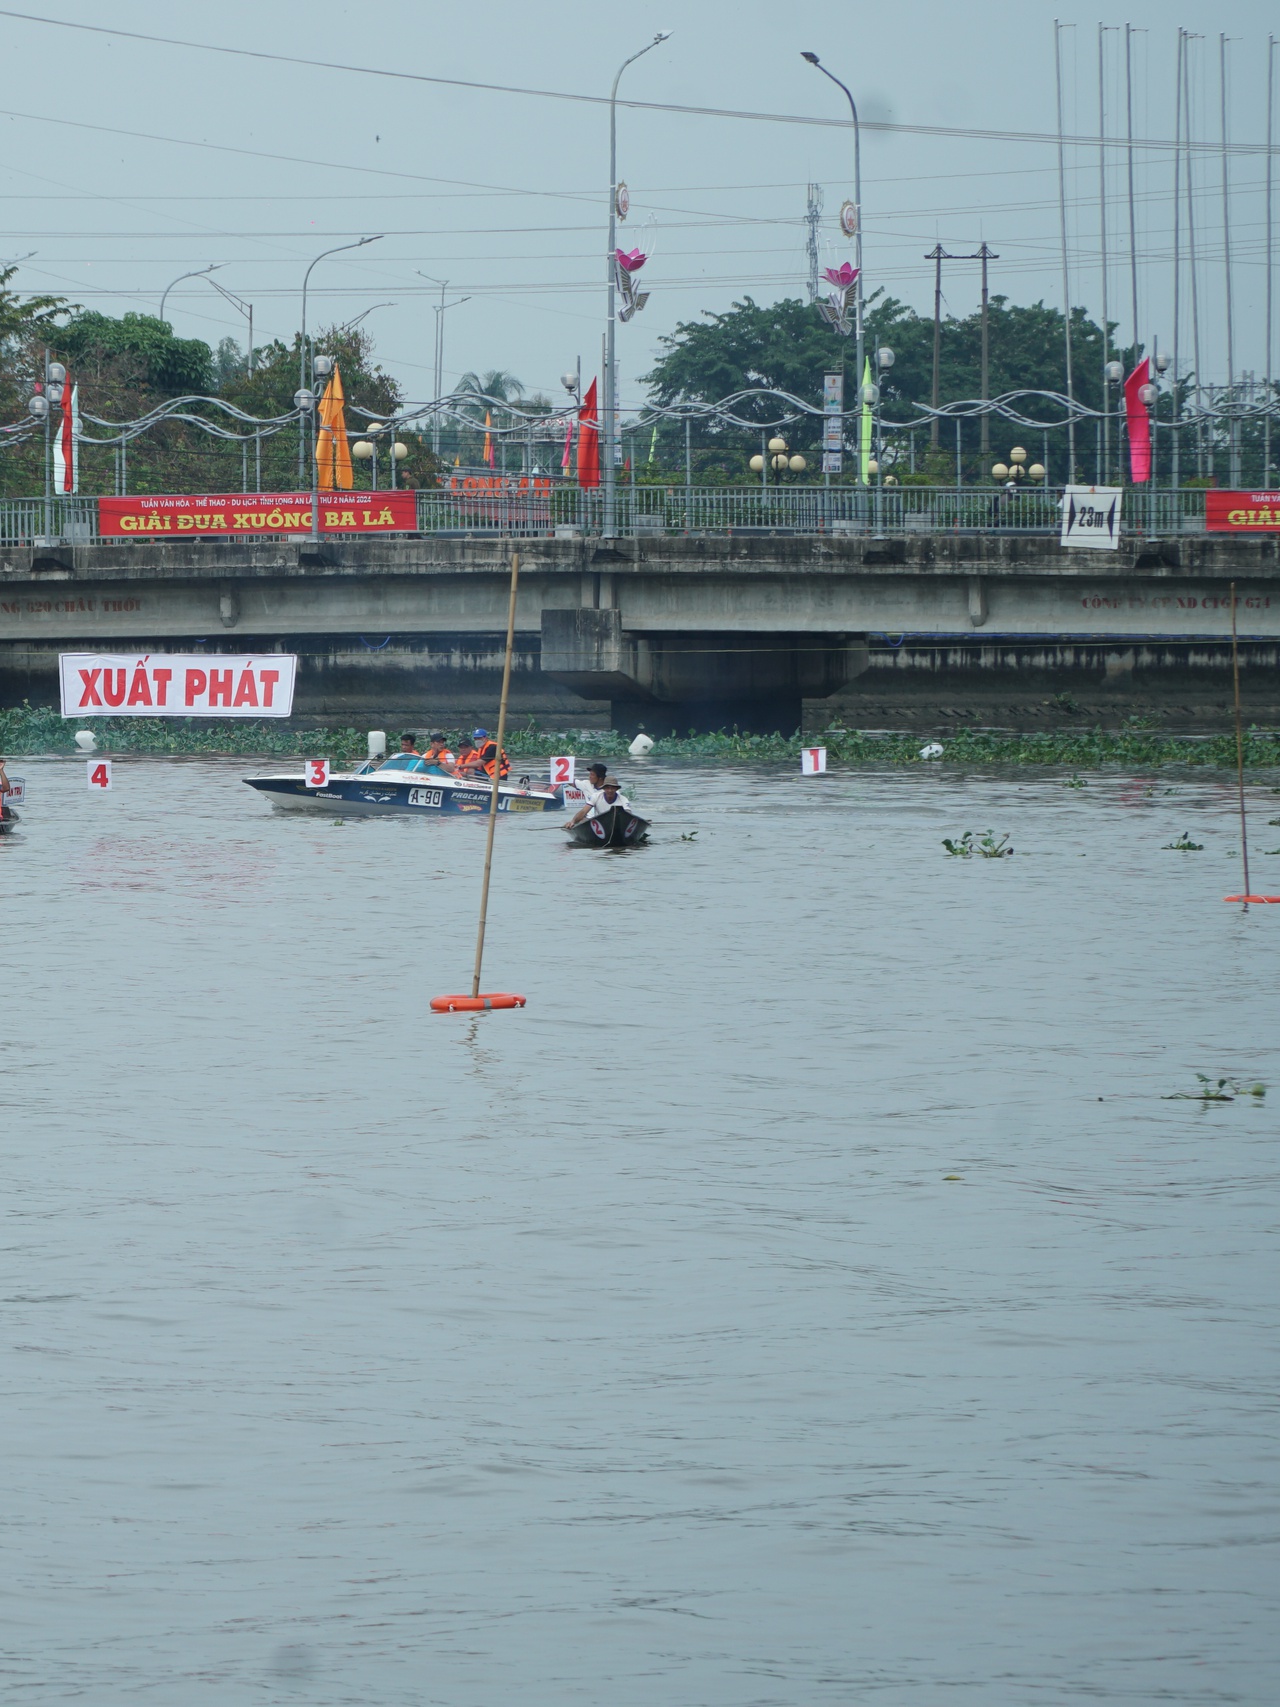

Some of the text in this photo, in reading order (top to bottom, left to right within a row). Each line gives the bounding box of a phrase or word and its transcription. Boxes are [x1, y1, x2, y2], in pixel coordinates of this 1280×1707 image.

[160, 499, 175, 507] VĂN
[176, 499, 190, 507] HÓA
[209, 499, 226, 507] THAO
[356, 496, 372, 504] 2024
[120, 506, 395, 531] GIẢI ĐUA XUỒNG BA LÁ
[1079, 506, 1104, 528] 23m
[1176, 597, 1197, 609] XD
[1245, 597, 1271, 609] 674
[78, 655, 280, 708] XUẤT PHÁT
[555, 758, 570, 782] 2
[809, 749, 820, 771] 1
[91, 764, 109, 787] 4
[310, 760, 326, 785] 3
[411, 790, 441, 805] A-90
[451, 792, 490, 801] PROCARE
[591, 820, 604, 835] 2
[626, 818, 637, 833] 2
